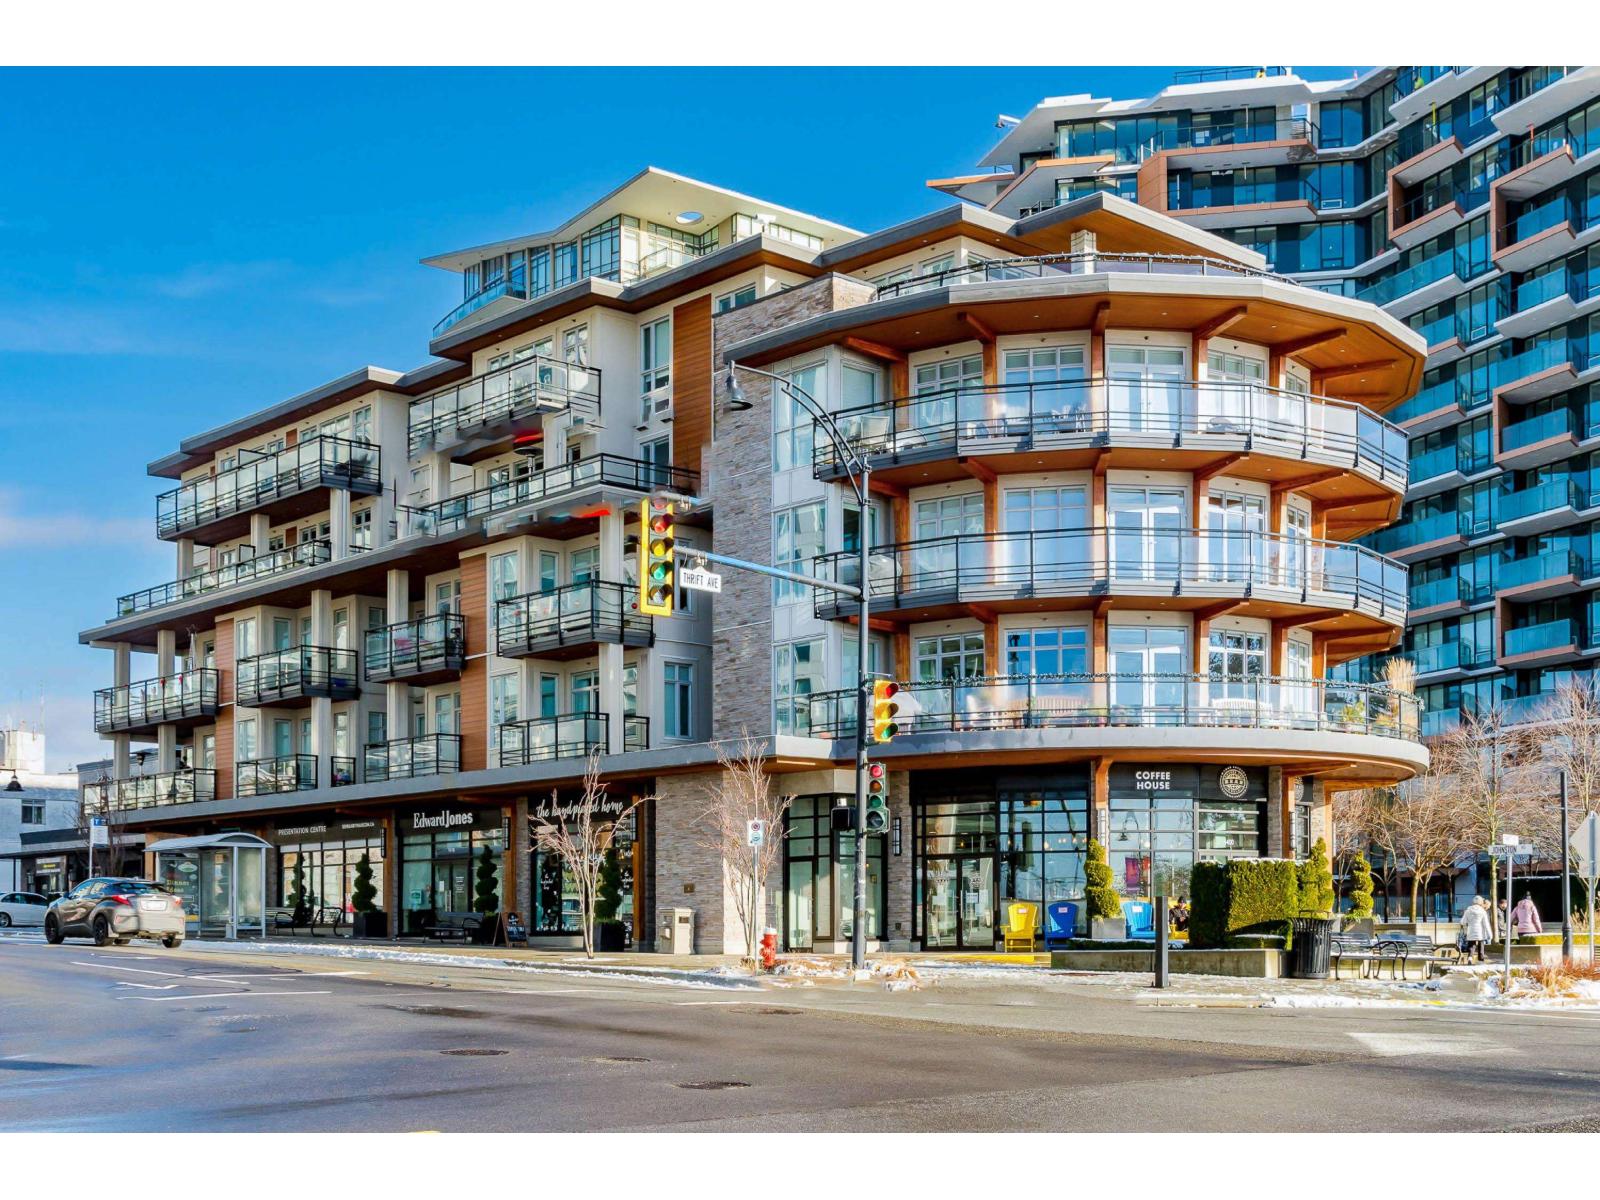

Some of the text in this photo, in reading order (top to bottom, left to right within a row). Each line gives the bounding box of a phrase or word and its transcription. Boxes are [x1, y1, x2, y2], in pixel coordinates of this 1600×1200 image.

[683, 572, 719, 589] THRIFT AVE
[1135, 771, 1171, 780] COFFEE
[1136, 781, 1170, 790] HOUSE
[536, 793, 624, 821] the handpid home
[278, 825, 327, 836] PRESENTATION CENTRE
